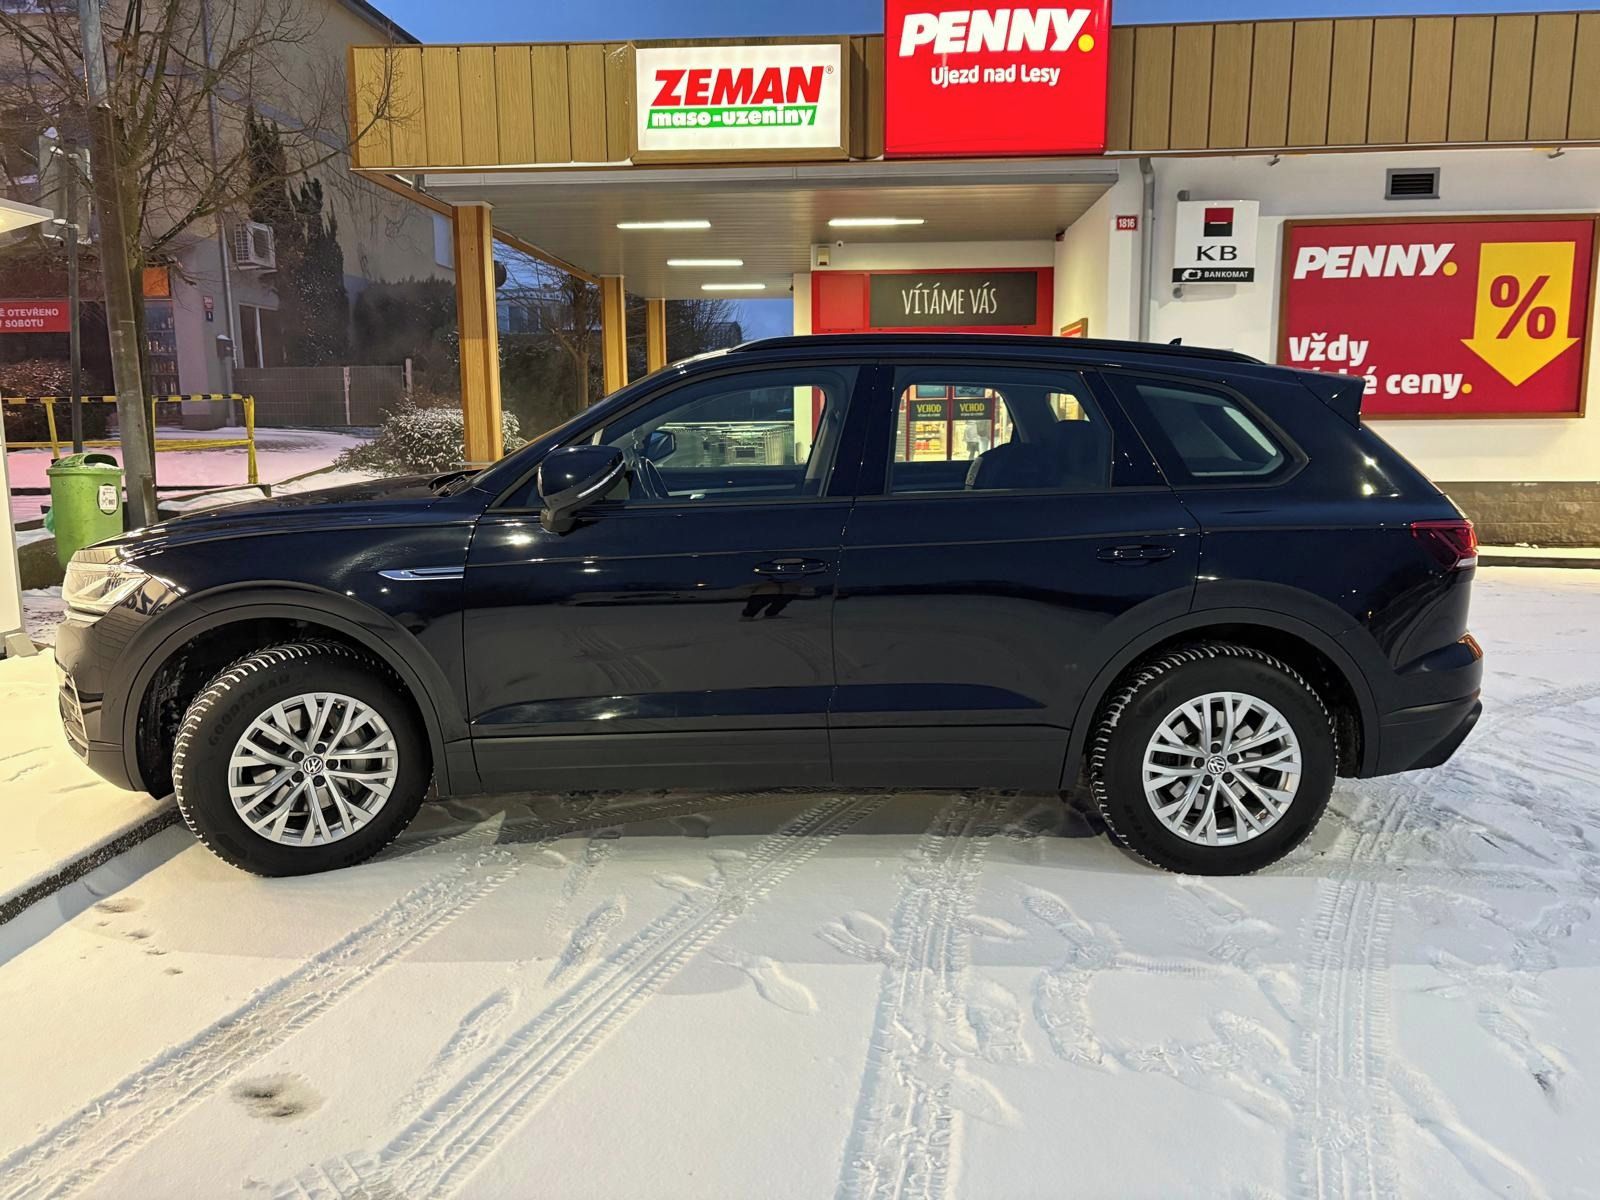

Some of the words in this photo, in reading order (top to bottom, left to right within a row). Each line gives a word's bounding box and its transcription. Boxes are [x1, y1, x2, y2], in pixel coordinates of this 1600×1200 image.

[983, 64, 1016, 83] nad
[1020, 64, 1061, 87] Lesy
[651, 66, 824, 106] ZEMAN
[651, 107, 814, 127] maso-uzeniny
[1196, 245, 1238, 261] KB
[1204, 270, 1249, 278] BANKOMAT
[902, 282, 965, 315] VÍTÁME
[969, 281, 997, 314] VÁS
[1490, 275, 1556, 339] %
[7, 307, 59, 317] OTEVŘENO
[5, 319, 44, 328] SOBOTU
[1289, 332, 1369, 367] Vždy
[916, 403, 942, 413] VCHOD
[960, 402, 985, 413] VCHOD
